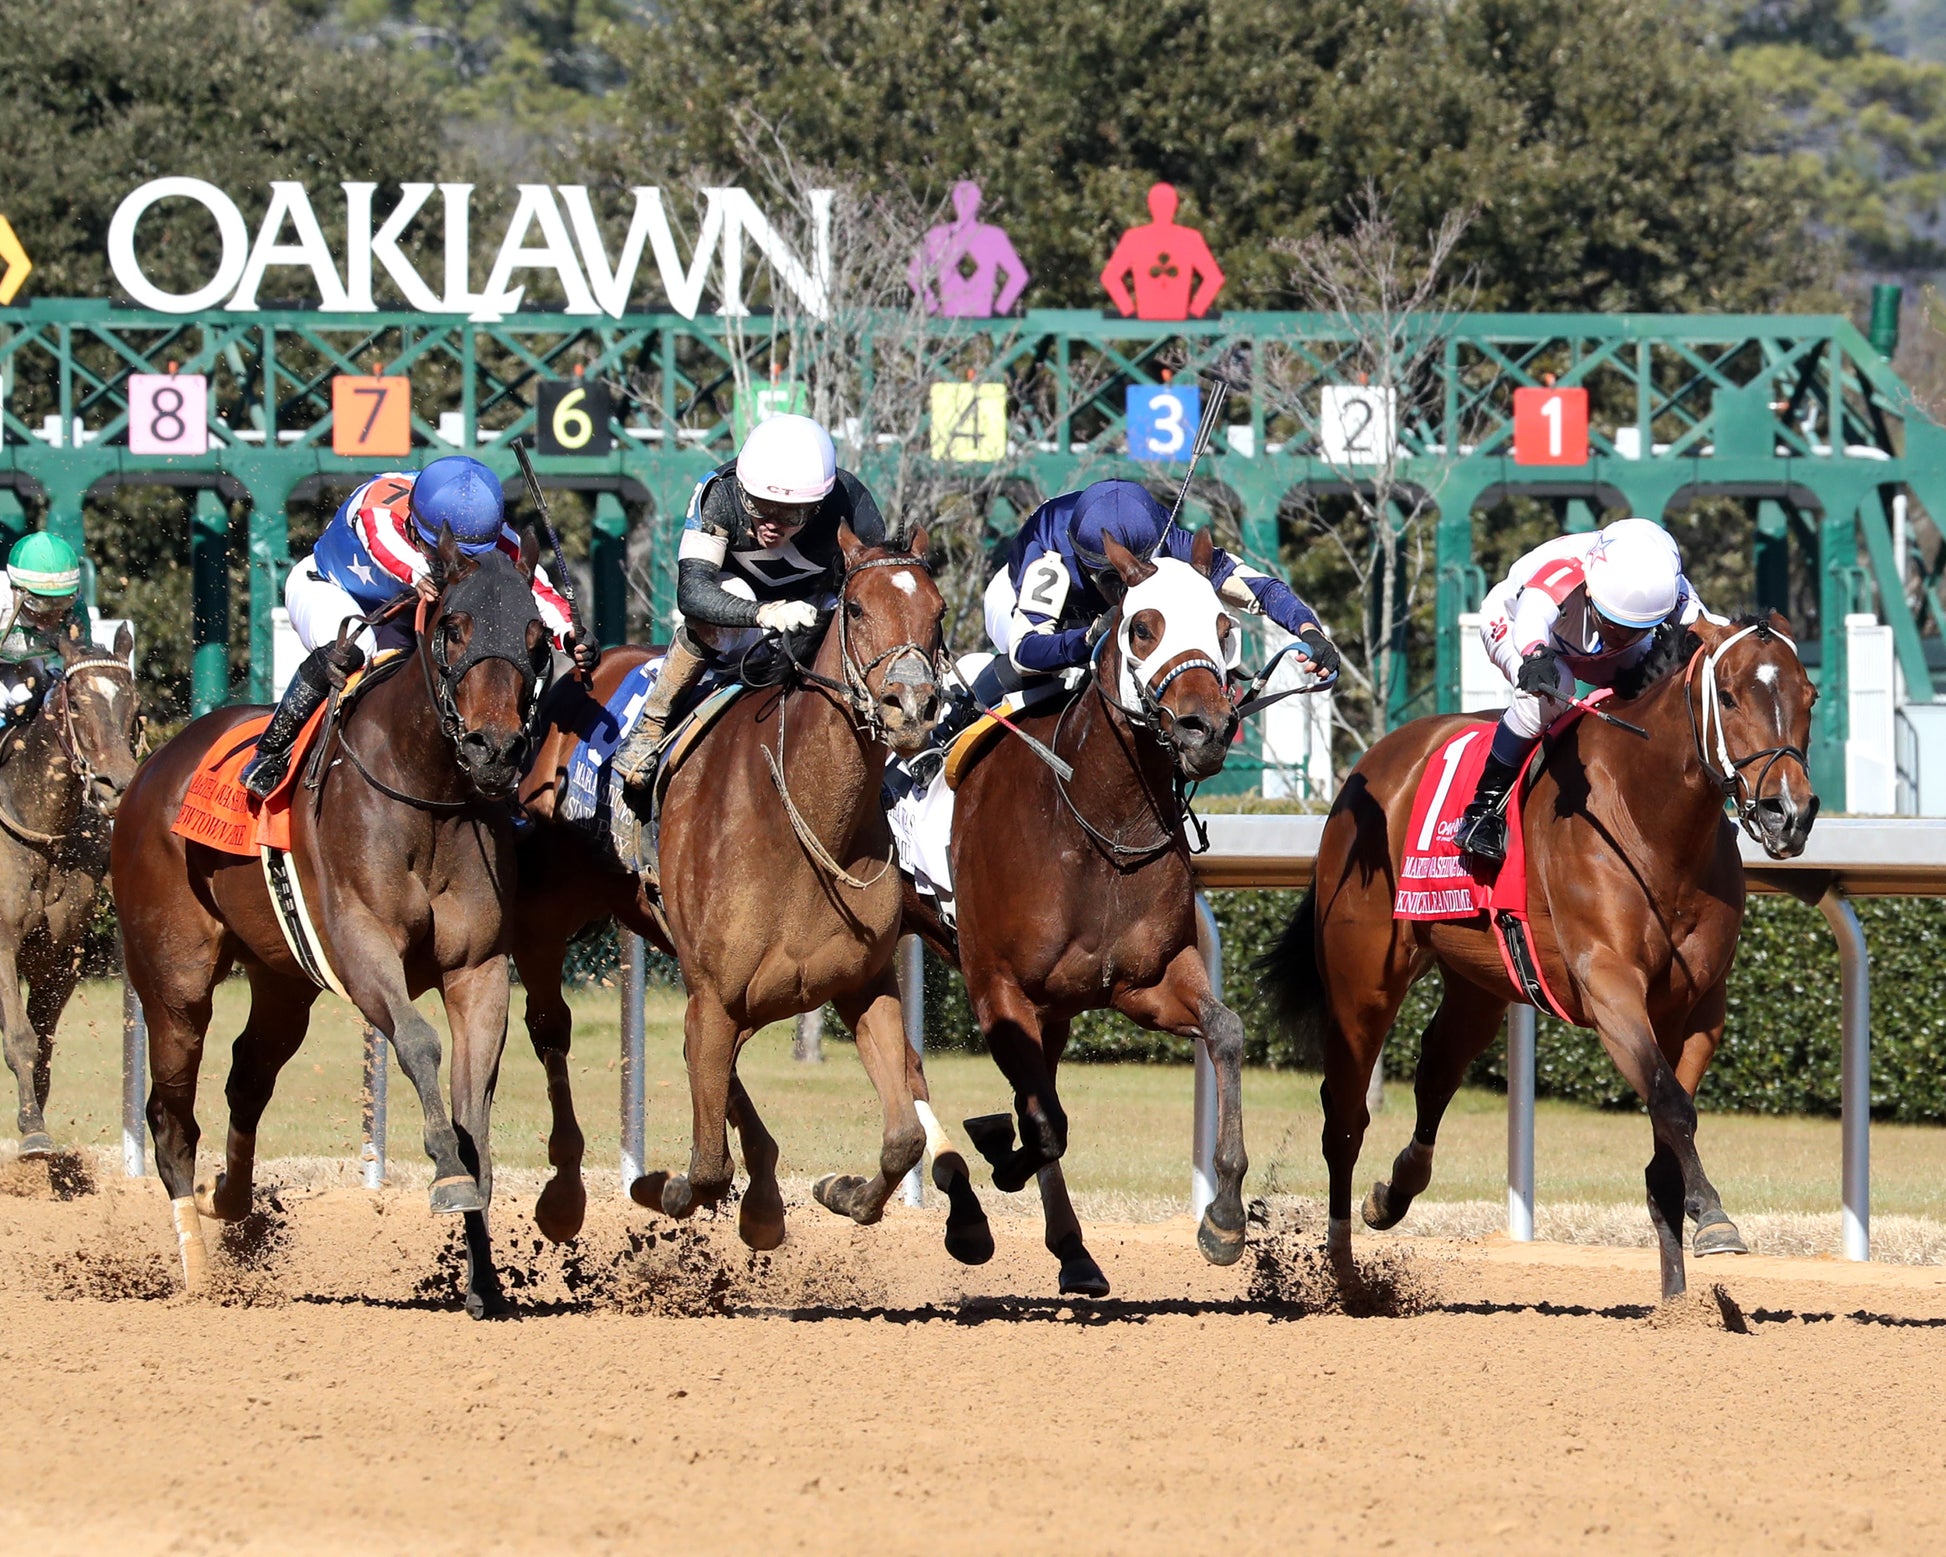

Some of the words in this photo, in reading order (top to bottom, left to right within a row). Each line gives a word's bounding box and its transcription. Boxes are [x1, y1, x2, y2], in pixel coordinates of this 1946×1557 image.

[107, 176, 836, 323] OAKLAWN
[151, 387, 185, 441] 8
[353, 388, 389, 444] 7
[552, 387, 593, 449] 6
[950, 397, 985, 449] 4
[1148, 393, 1184, 454] 3
[1342, 399, 1372, 451] 2
[1540, 396, 1562, 457] 1
[382, 483, 410, 505] 7
[766, 485, 794, 496] CT
[1031, 567, 1059, 605] 2
[1416, 731, 1480, 851] 1
